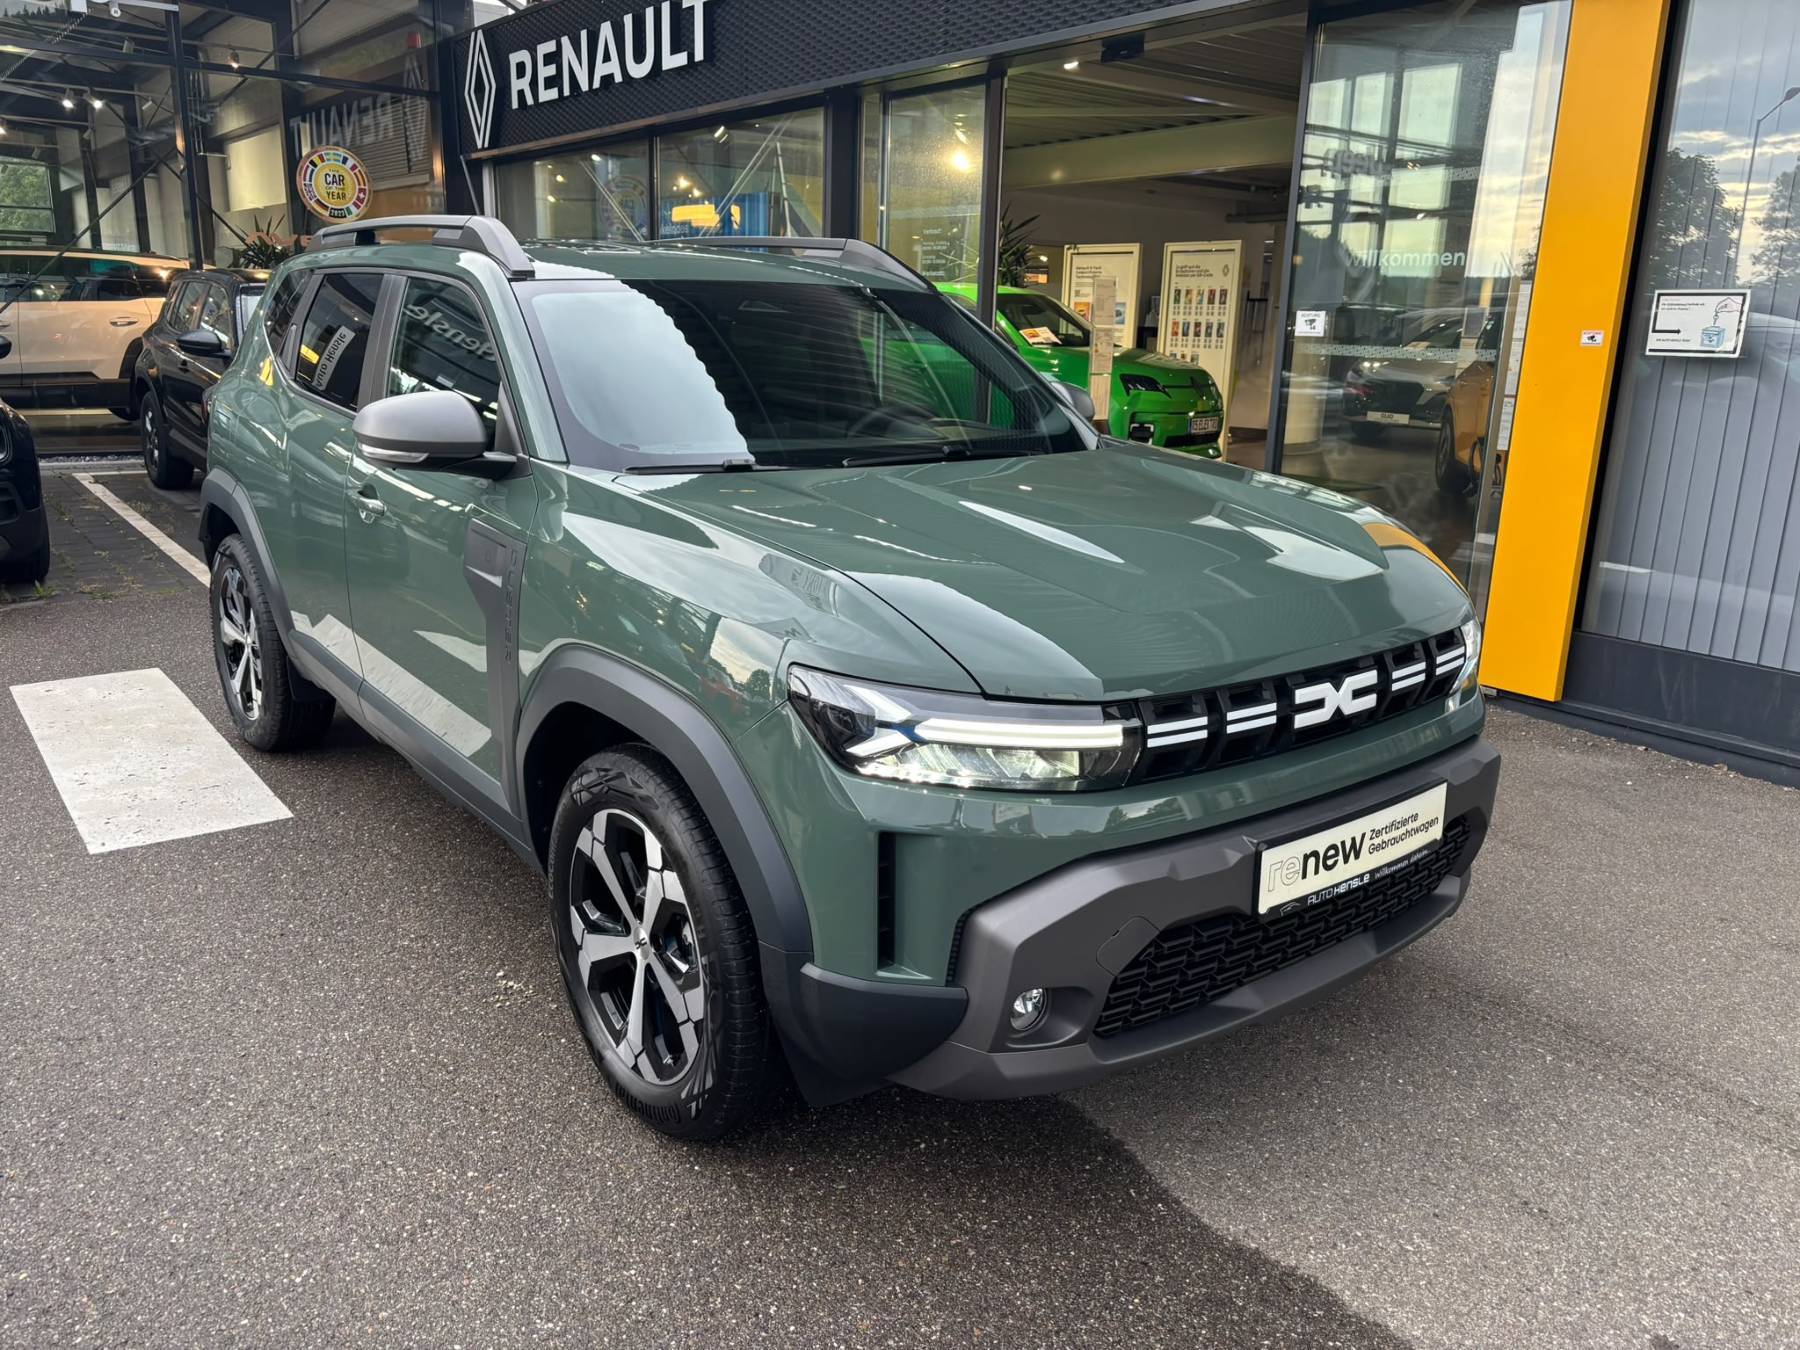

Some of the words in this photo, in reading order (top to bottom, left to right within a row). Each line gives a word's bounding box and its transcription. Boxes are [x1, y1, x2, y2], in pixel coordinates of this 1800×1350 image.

[508, 0, 708, 110] RENAULT
[324, 173, 345, 187] CAR
[326, 191, 347, 201] YEAR
[1368, 816, 1439, 855] Gebrauchtwagen
[1369, 812, 1419, 841] Zertifizierte
